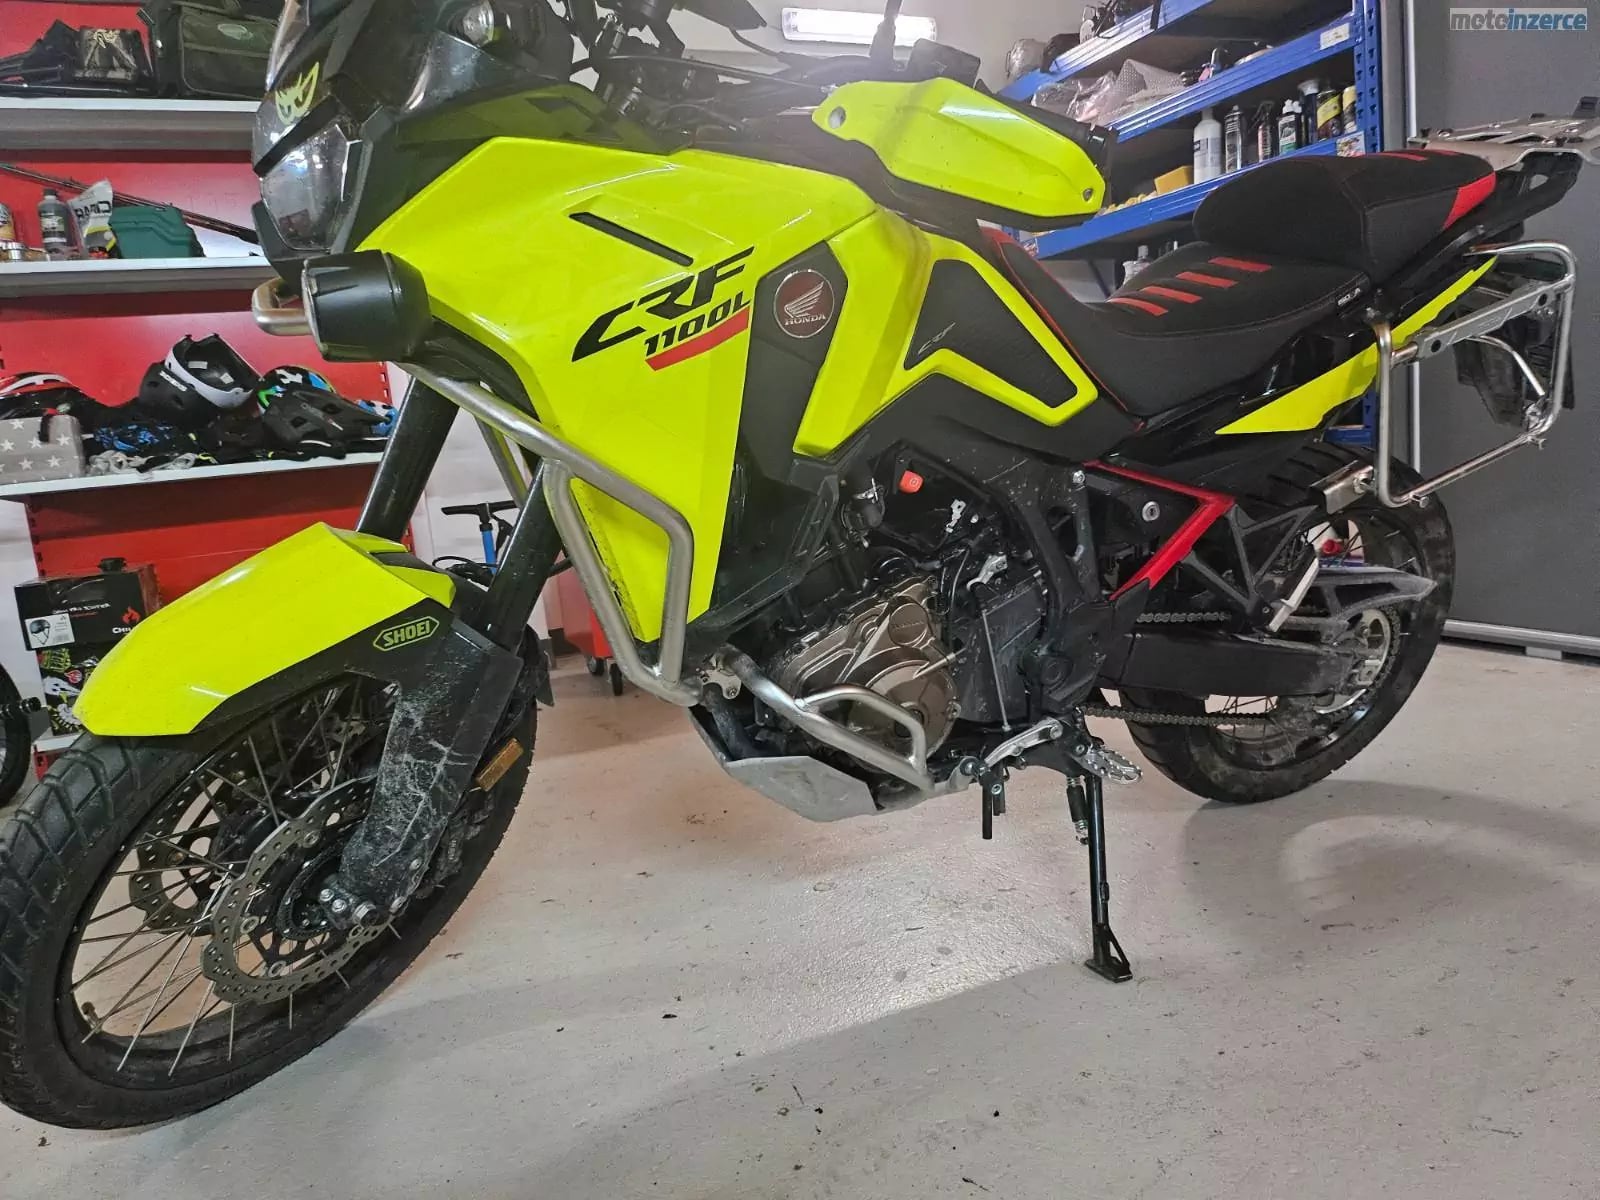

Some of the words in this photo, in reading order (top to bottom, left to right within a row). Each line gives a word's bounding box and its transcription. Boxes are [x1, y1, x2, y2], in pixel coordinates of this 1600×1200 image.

[571, 246, 755, 362] CRF
[644, 291, 751, 357] 1100L
[784, 313, 827, 326] HONDA
[382, 620, 431, 647] SHOEI
